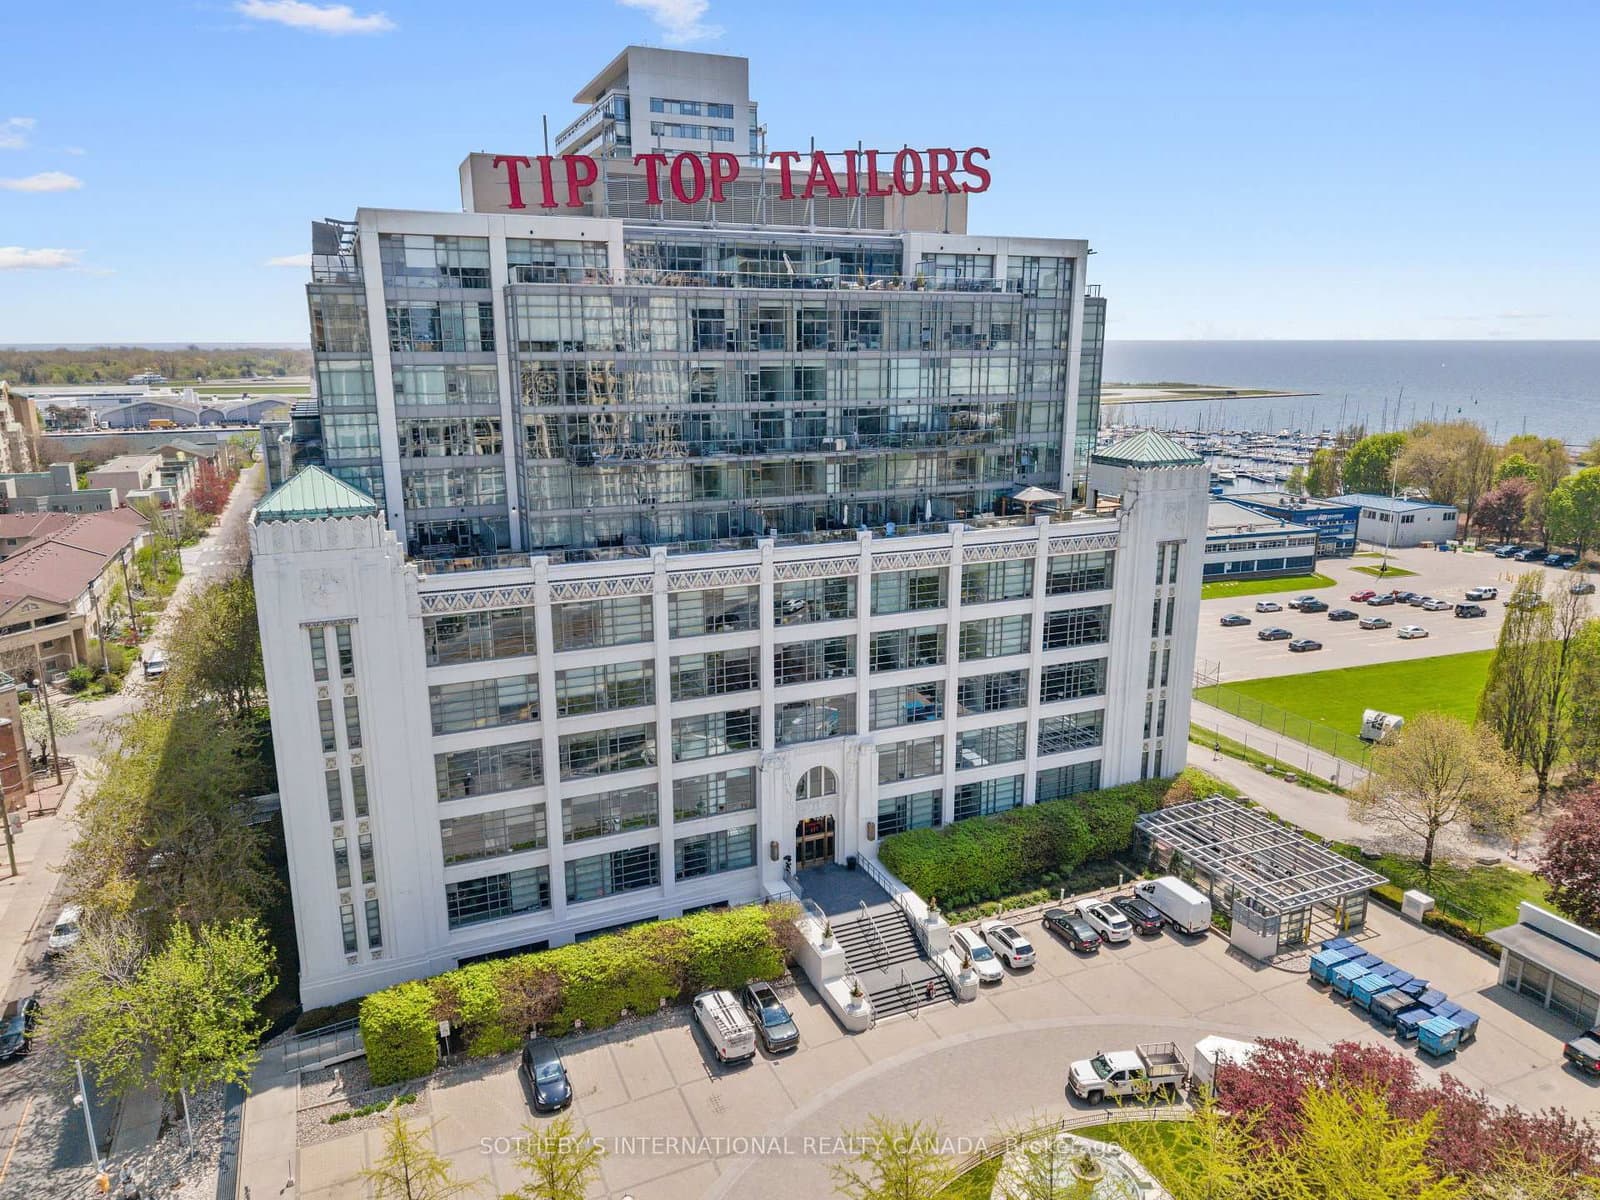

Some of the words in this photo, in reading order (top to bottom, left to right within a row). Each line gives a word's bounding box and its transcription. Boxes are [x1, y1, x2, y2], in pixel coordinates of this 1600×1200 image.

[493, 154, 598, 209] TIP
[633, 152, 740, 205] TOP
[769, 147, 991, 200] TAILORS
